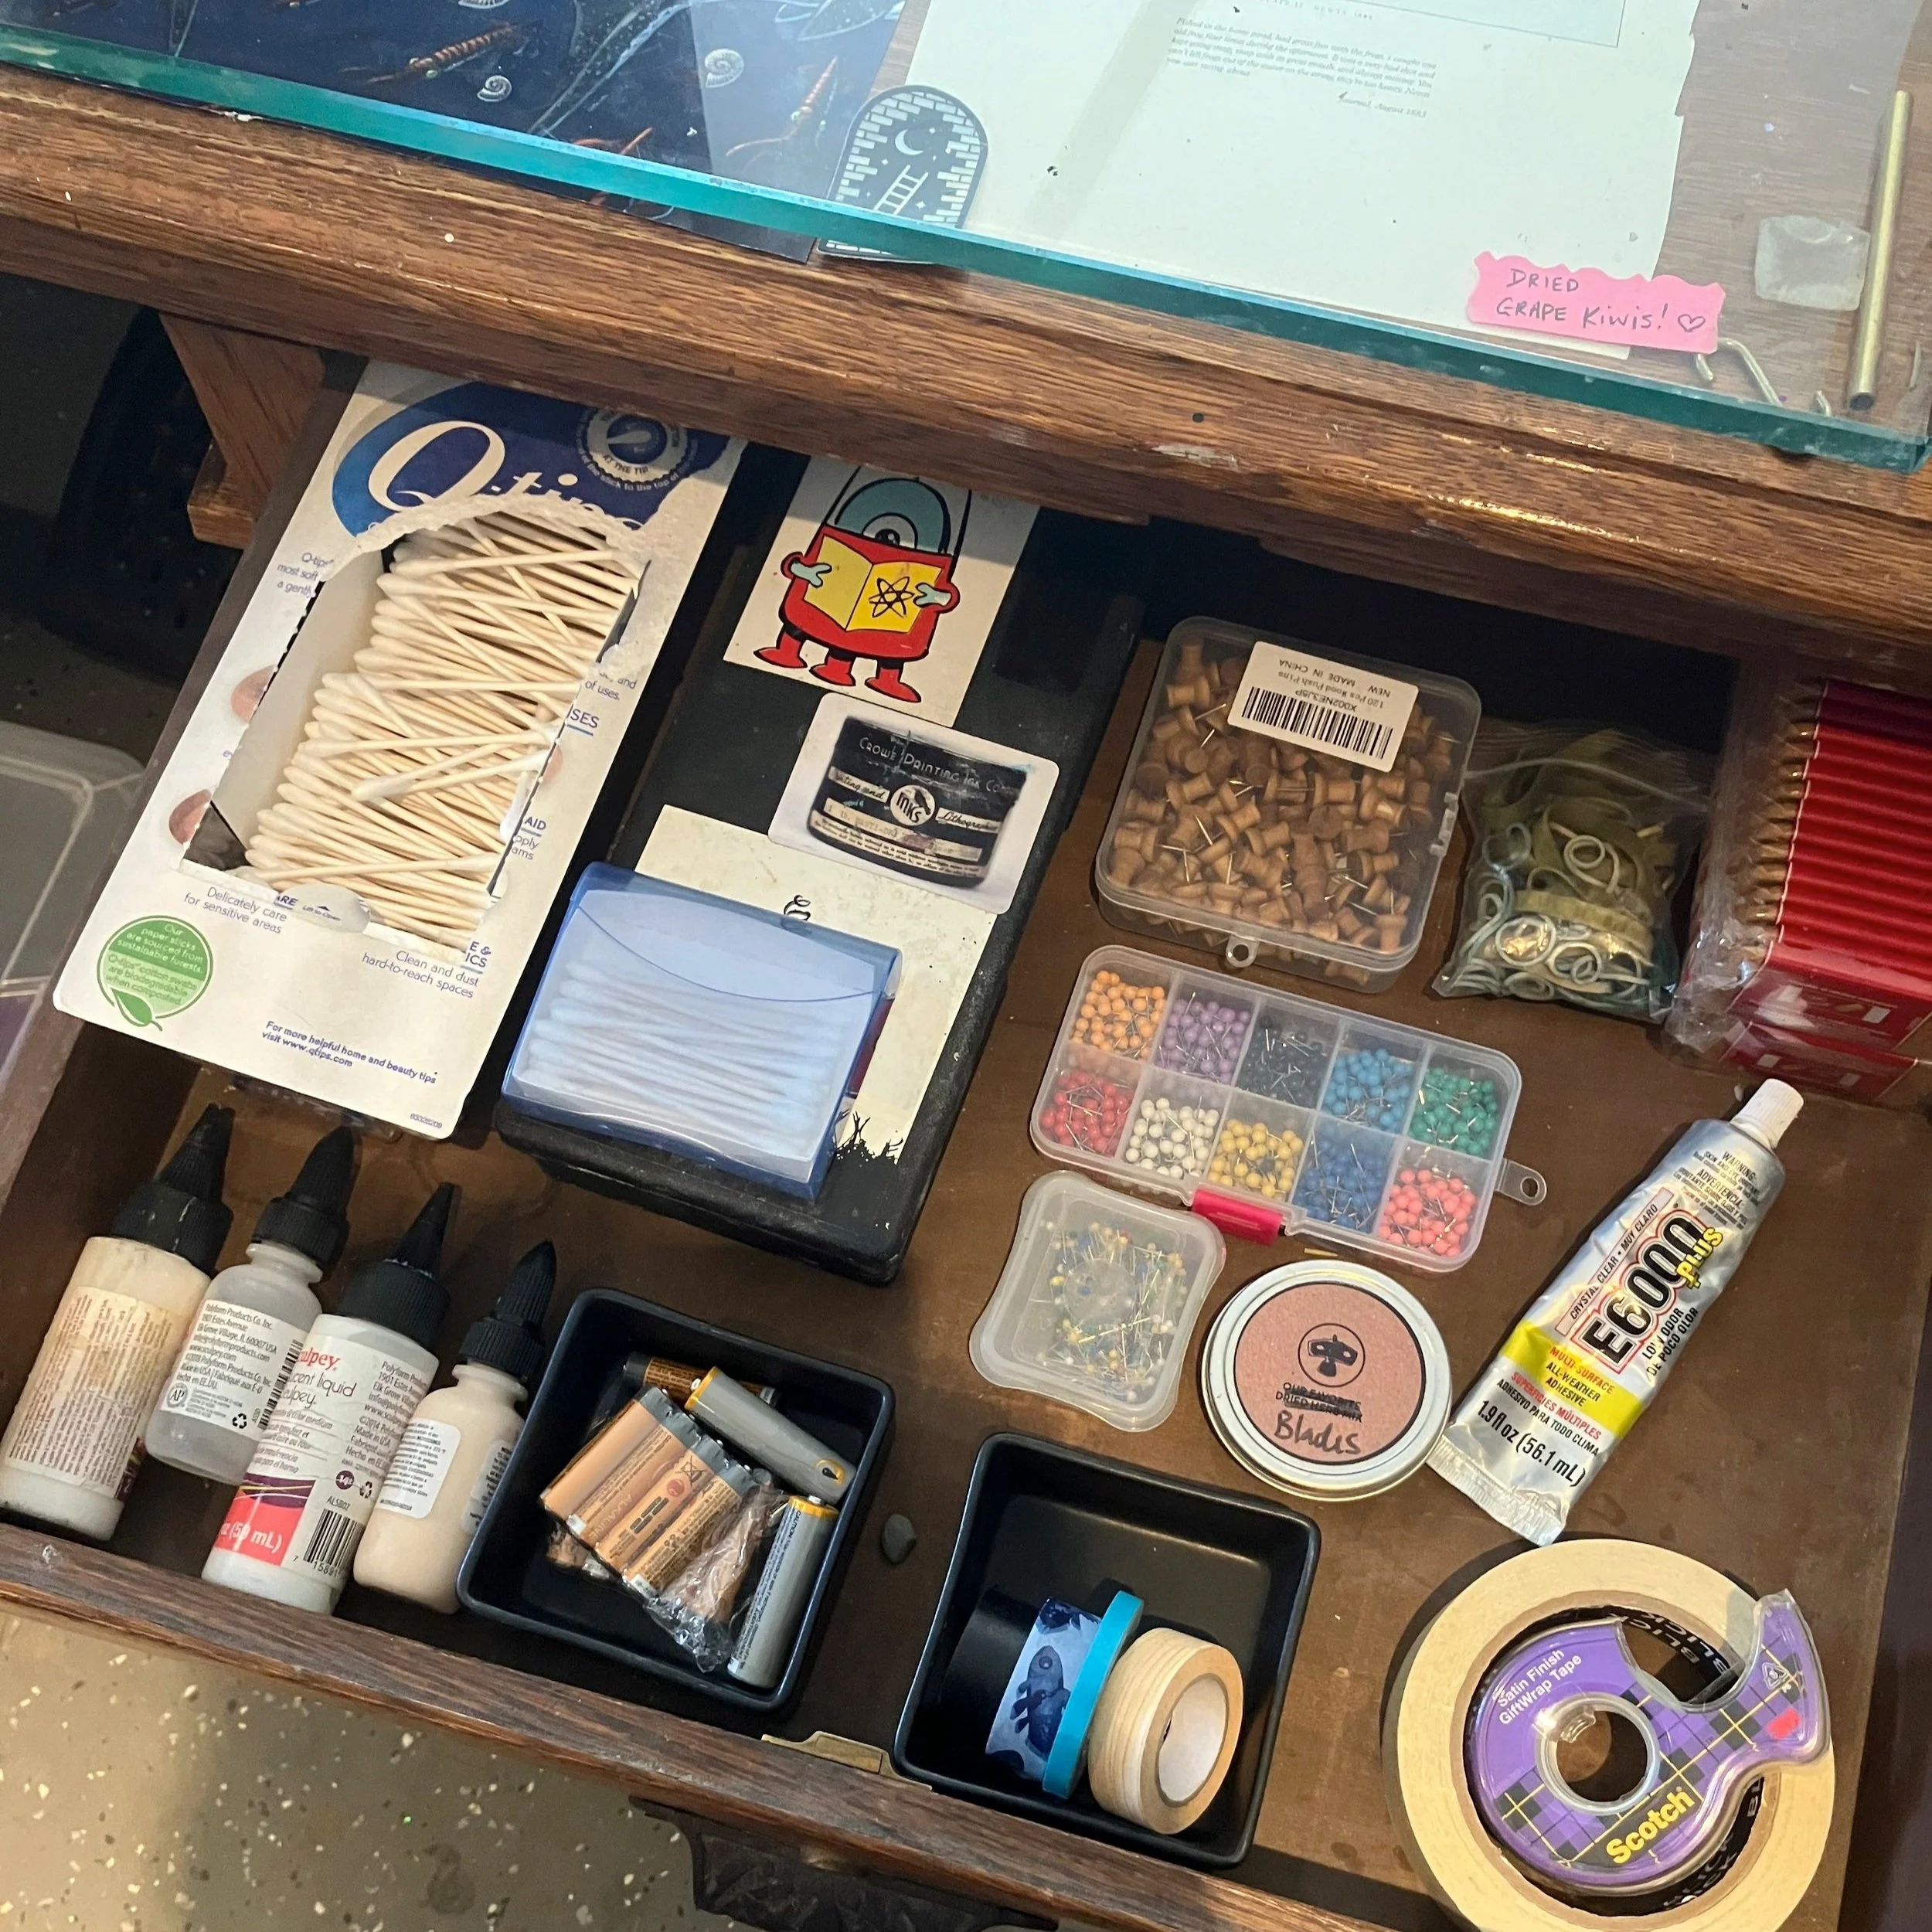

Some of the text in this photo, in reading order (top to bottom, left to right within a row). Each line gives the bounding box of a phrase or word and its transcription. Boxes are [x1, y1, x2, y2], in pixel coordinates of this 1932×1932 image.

[1506, 268, 1580, 292] DRIED
[1496, 298, 1567, 322] GRAPE
[277, 563, 299, 576] most
[585, 679, 597, 690] of
[1277, 658, 1391, 697] NEW MADE IN CHINA
[1277, 670, 1384, 708] 120 Pcs Wood Push Pins
[524, 815, 547, 832] AID
[182, 891, 282, 934] for sensitive areas
[206, 885, 287, 923] Delicately care
[140, 927, 168, 942] paper
[164, 923, 184, 937] Our
[117, 938, 169, 961] sustainable
[125, 932, 204, 963] are sourced from
[479, 945, 492, 956] &
[362, 952, 474, 999] hard-to-reach spaces
[395, 948, 479, 987] Clean and dust
[261, 1031, 352, 1067] visit www.qtips.com
[265, 1020, 284, 1032] For
[283, 1027, 308, 1041] more
[308, 1035, 341, 1053] helpful
[341, 1046, 367, 1061] home
[367, 1055, 386, 1067] and
[386, 1060, 418, 1080] beauty
[1568, 1202, 1659, 1319] CRYSTAL CLEAR MUY CLARO
[1581, 1215, 1705, 1366] E6000
[211, 1315, 248, 1332] Estes Avenue
[226, 1307, 253, 1322] Products
[261, 1318, 274, 1330] Inc.
[1657, 1332, 1682, 1362] POCO
[1675, 1305, 1699, 1334] OLOR
[1659, 1307, 1684, 1337] ODOR
[202, 1323, 219, 1334] Grove
[217, 1327, 240, 1342] Village,
[244, 1335, 267, 1350] 60007
[264, 1342, 278, 1355] USA
[199, 1355, 228, 1371] Polyform
[226, 1362, 254, 1379] Products
[199, 1365, 212, 1376] USA
[376, 1371, 394, 1385] 1901
[393, 1378, 409, 1392] Estes
[381, 1360, 410, 1379] Polyform
[1545, 1360, 1601, 1402] ALL-WEATHER
[1548, 1345, 1615, 1396] MULTI-SURFACE
[169, 1389, 185, 1402] AP
[317, 1372, 357, 1397] liquid
[372, 1380, 402, 1400] Elk Grove
[1544, 1375, 1586, 1407] ADHESIVE
[1496, 1377, 1600, 1457] ADHESIVO PARA TODO CLIMA
[1510, 1370, 1602, 1440] SUPERFICIES MÚLTIPLES
[353, 1424, 374, 1439] Made
[372, 1433, 380, 1442] in
[379, 1435, 391, 1447] USA
[345, 1445, 376, 1465] Hecho en
[1499, 1421, 1520, 1444] oz
[1514, 1430, 1556, 1468] (56.1
[1551, 1455, 1587, 1490] mL)
[249, 1526, 284, 1555] mL)
[1497, 1648, 1565, 1708] Satin Finish
[1498, 1654, 1582, 1725] GiftWrap Tape
[1606, 1789, 1696, 1864] Scotch
